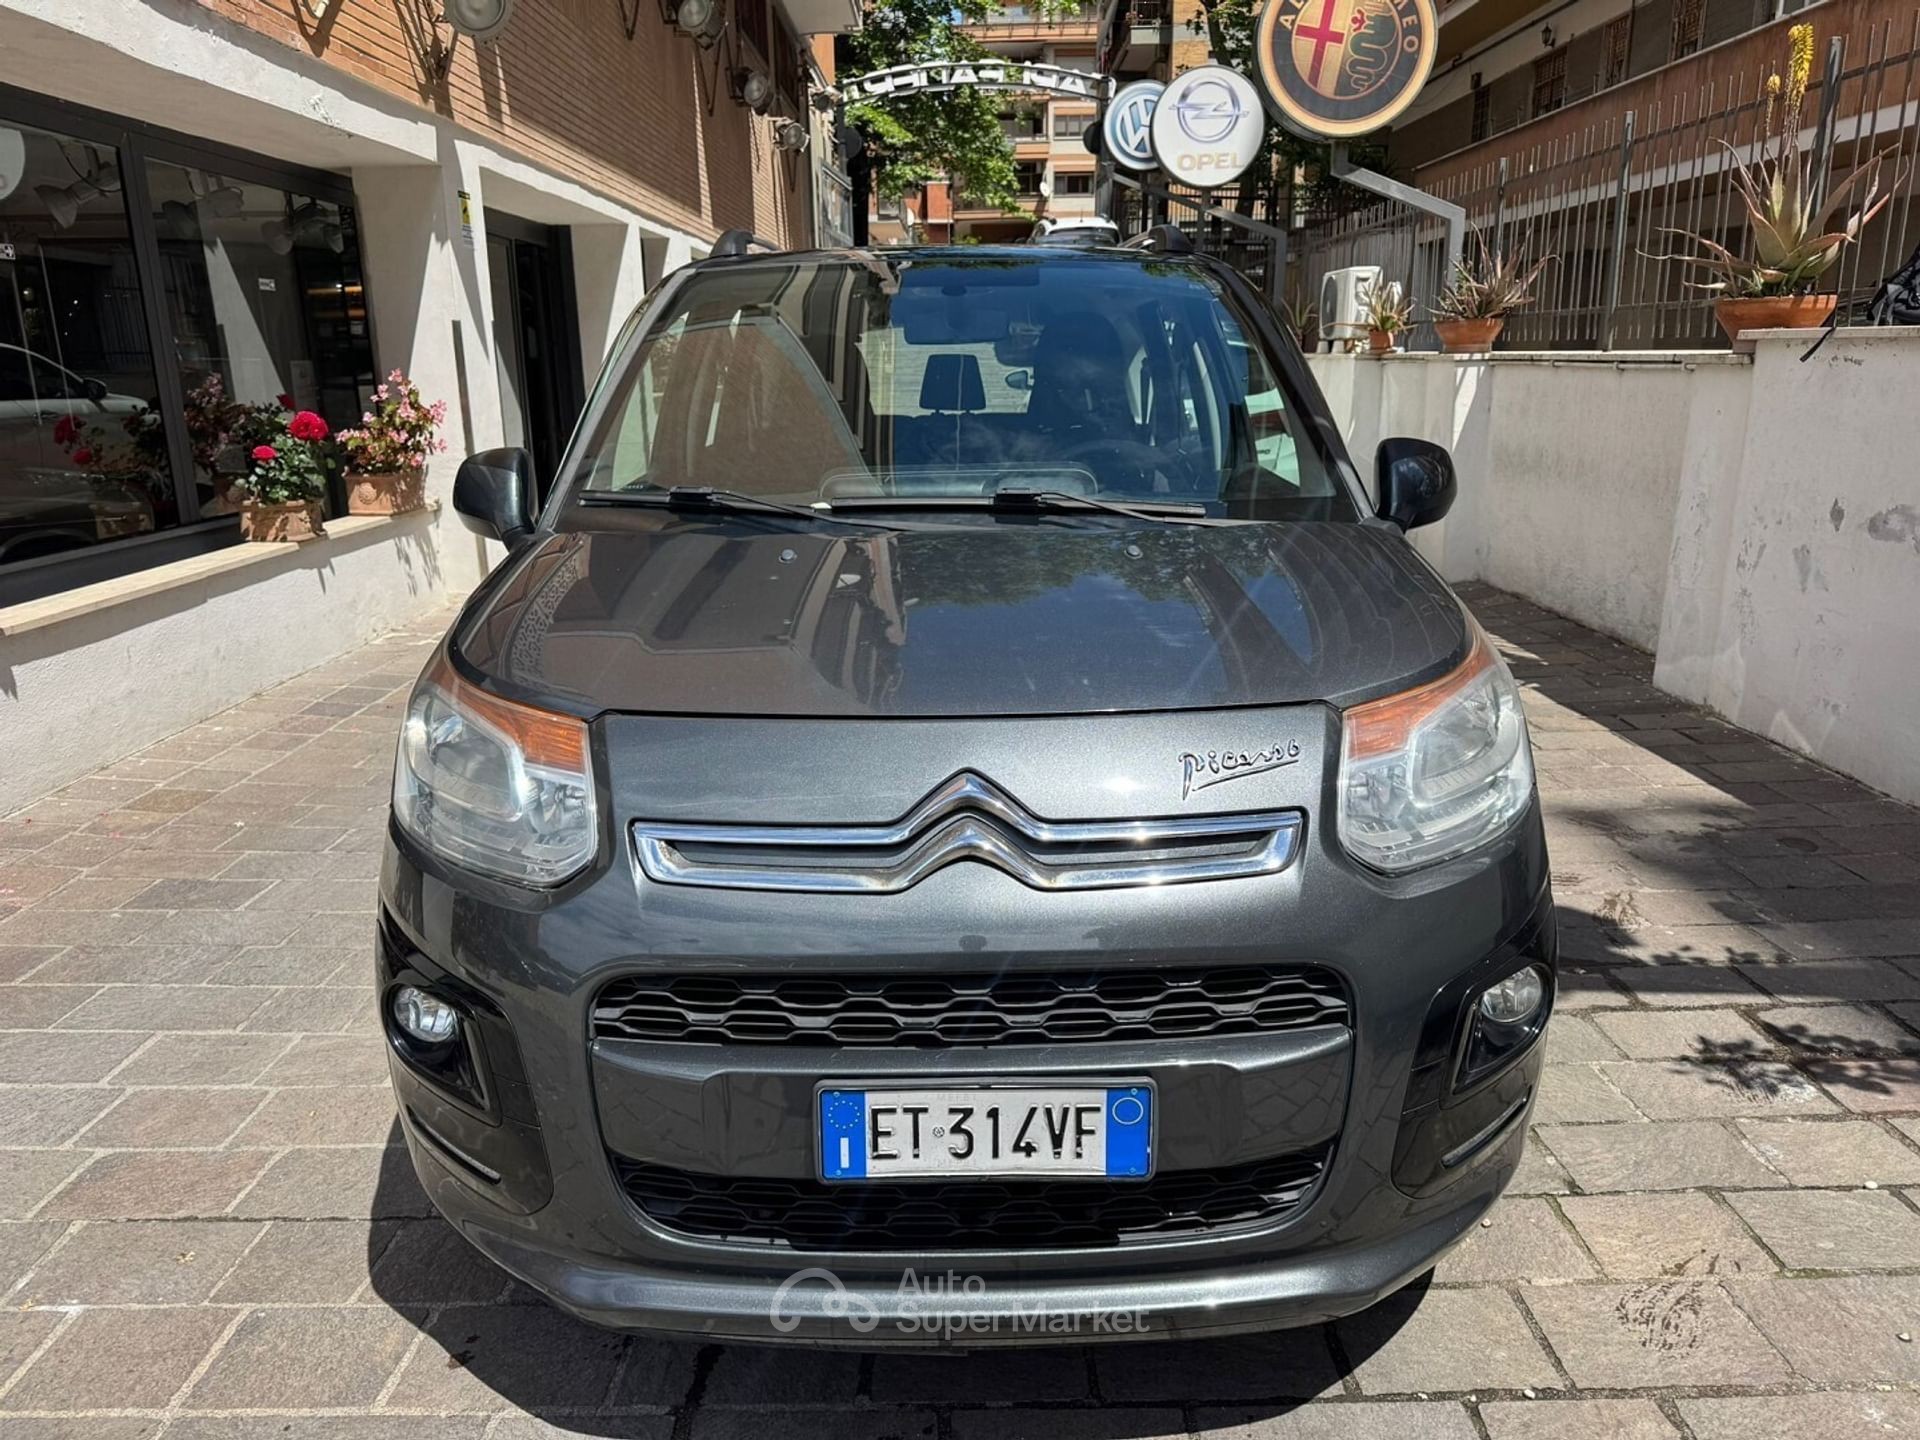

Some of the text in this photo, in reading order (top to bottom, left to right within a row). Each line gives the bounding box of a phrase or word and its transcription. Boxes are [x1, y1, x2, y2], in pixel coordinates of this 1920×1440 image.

[1176, 151, 1245, 172] OPEL
[1178, 738, 1302, 801] Picasso
[870, 1105, 929, 1160] ET
